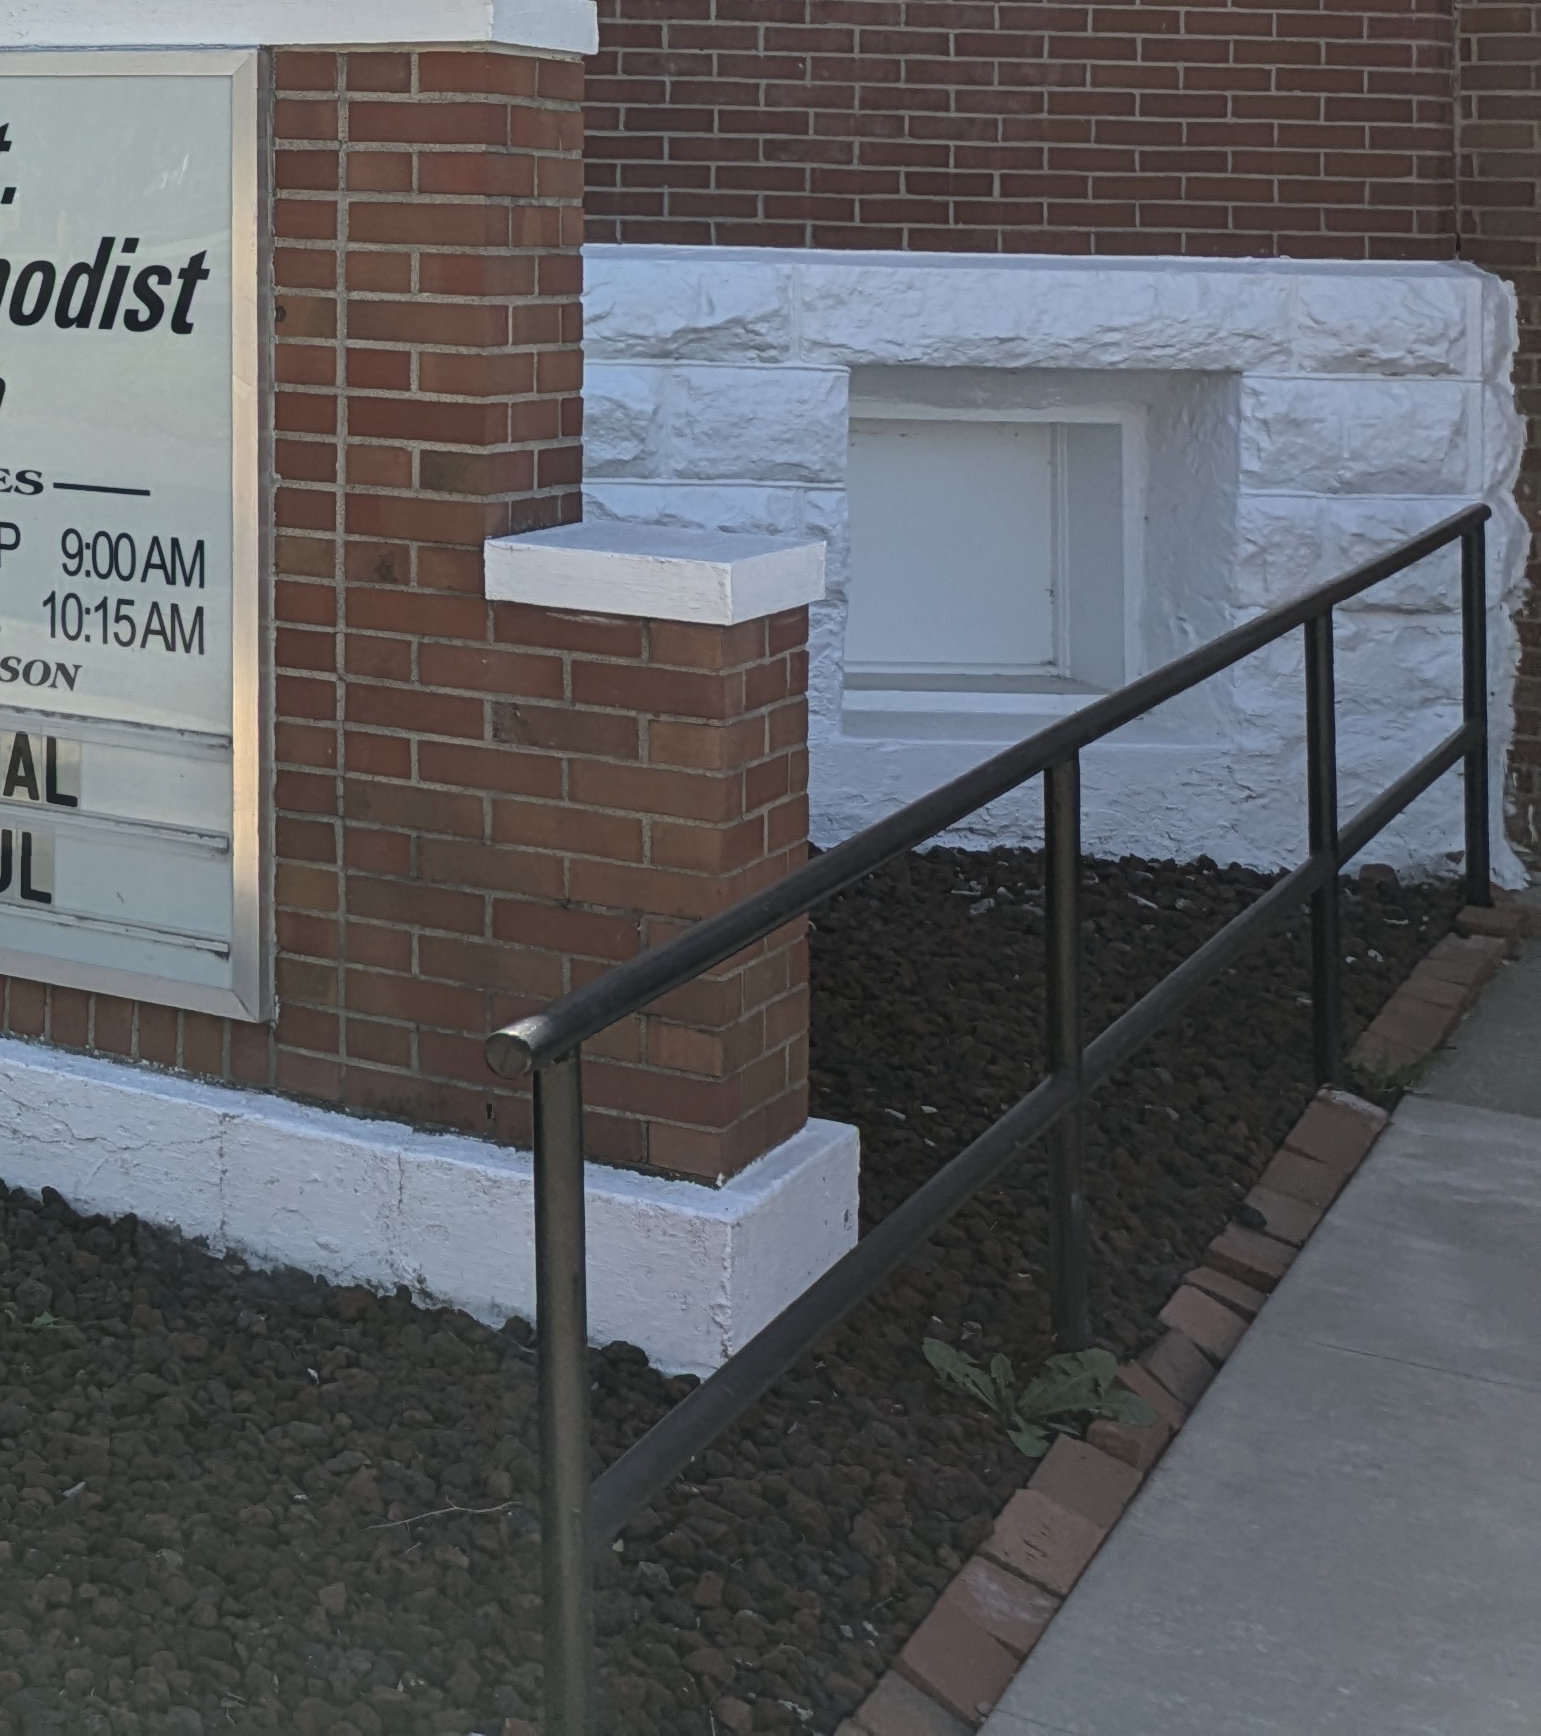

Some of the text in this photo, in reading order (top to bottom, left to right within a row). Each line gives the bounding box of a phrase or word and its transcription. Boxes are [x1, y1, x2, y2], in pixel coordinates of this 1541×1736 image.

[60, 528, 138, 583] 9:00
[141, 537, 207, 589] AM
[41, 590, 137, 647] 10:15
[140, 604, 207, 656] AM
